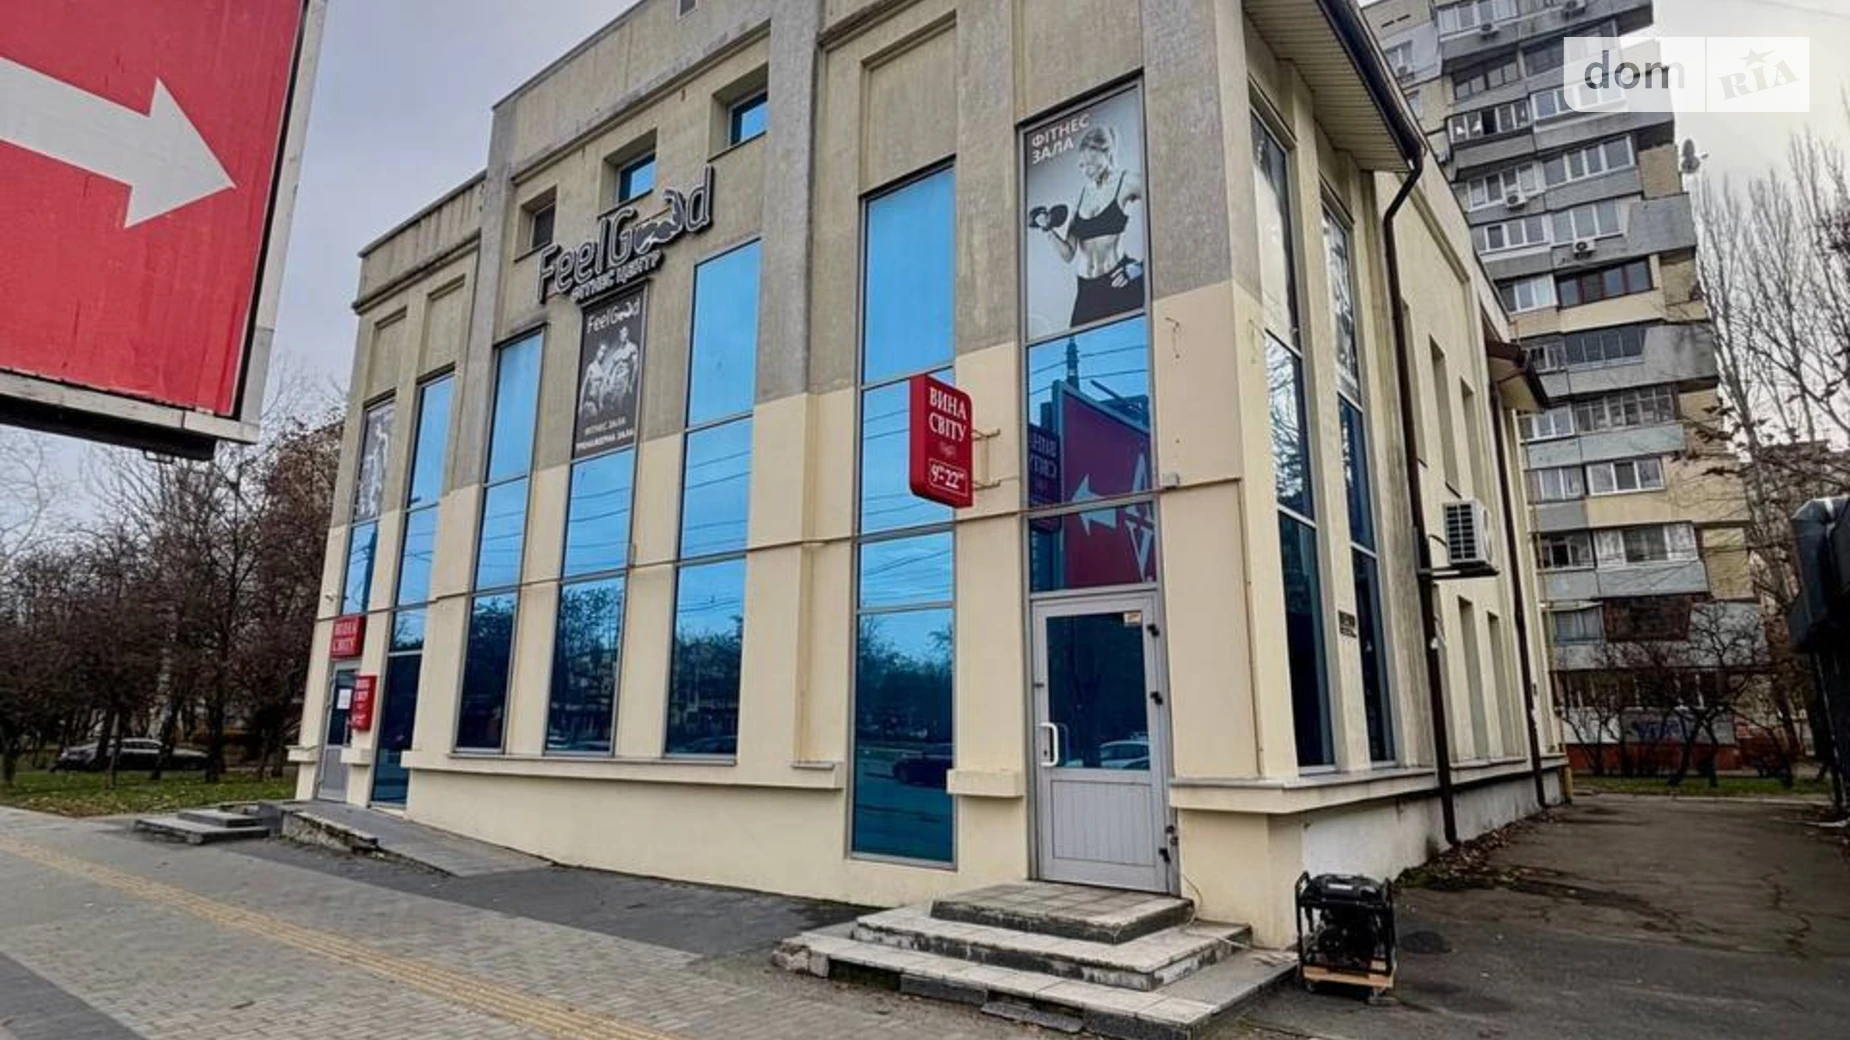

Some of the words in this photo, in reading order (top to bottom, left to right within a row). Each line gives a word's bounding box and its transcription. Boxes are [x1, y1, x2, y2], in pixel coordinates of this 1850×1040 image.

[1032, 113, 1090, 147] ФІТНЕС
[1032, 137, 1074, 165] ЗАЛА
[929, 386, 967, 420] ВИНА
[928, 411, 967, 442] СВІТУ
